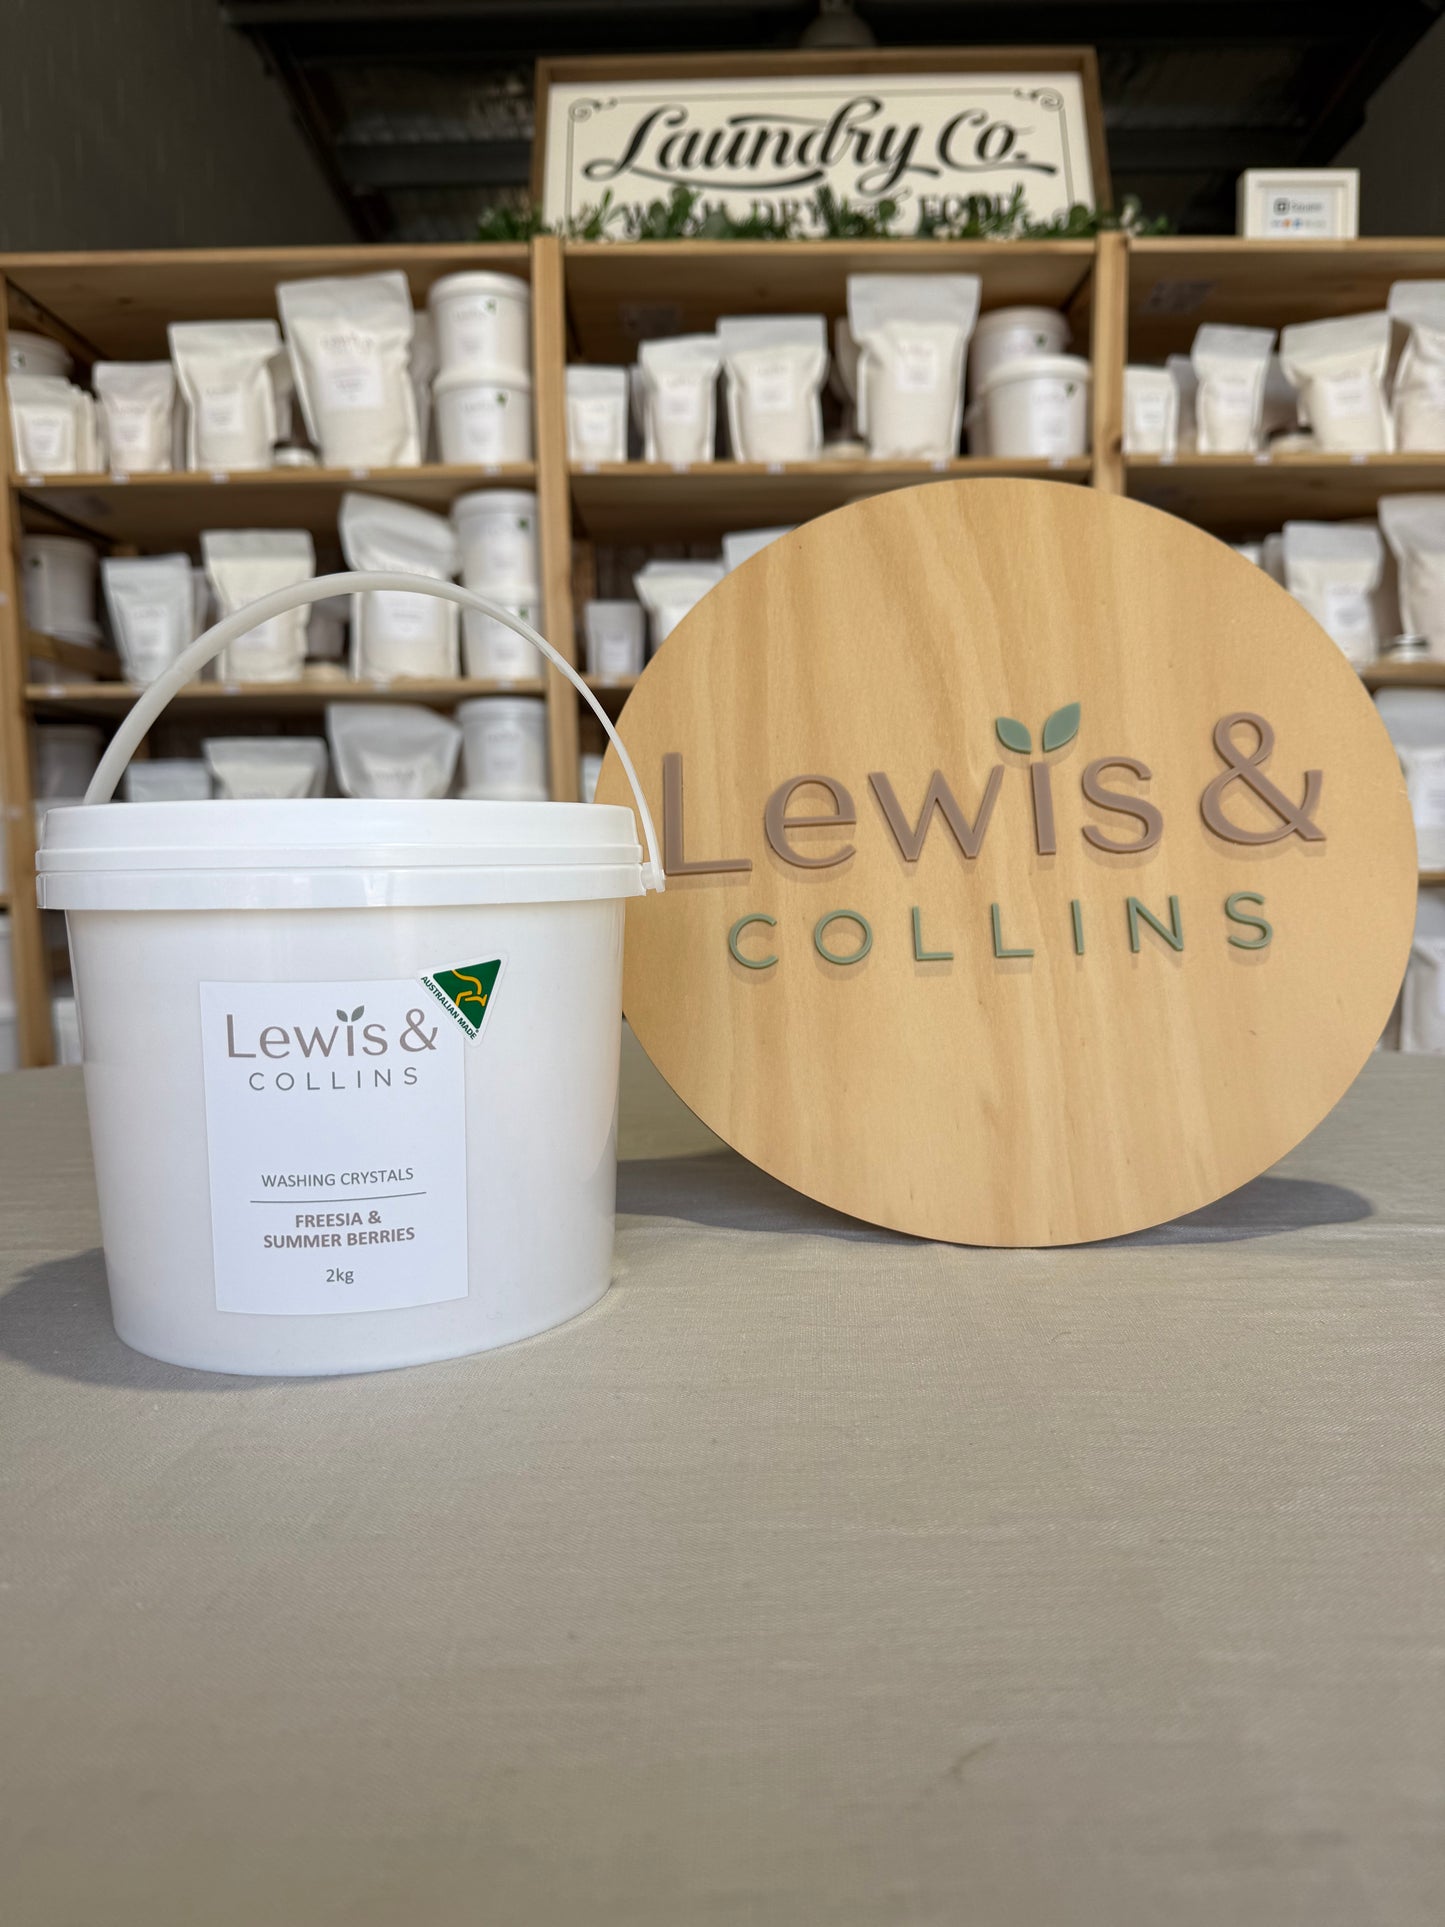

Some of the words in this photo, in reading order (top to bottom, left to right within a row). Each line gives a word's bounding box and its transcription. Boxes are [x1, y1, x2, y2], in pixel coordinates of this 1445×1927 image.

[581, 95, 942, 197] Laundry
[935, 107, 1059, 175] Co.
[663, 751, 1164, 877] Lewis
[1199, 711, 1327, 846] &
[727, 891, 1274, 970] COLLINS
[420, 975, 460, 1020] AUSTRALIAN
[456, 1017, 478, 1041] MADE
[225, 1013, 389, 1060] Lewis
[399, 1007, 439, 1053] &
[248, 1066, 418, 1092] COLLINS
[261, 1173, 336, 1188] WASHING
[340, 1167, 414, 1186] CRYSTALS
[263, 1230, 342, 1249] SUMMER
[347, 1226, 415, 1247] BERRIES
[294, 1211, 363, 1229] FREESIA
[367, 1209, 382, 1225] &
[325, 1267, 355, 1285] 2kg
